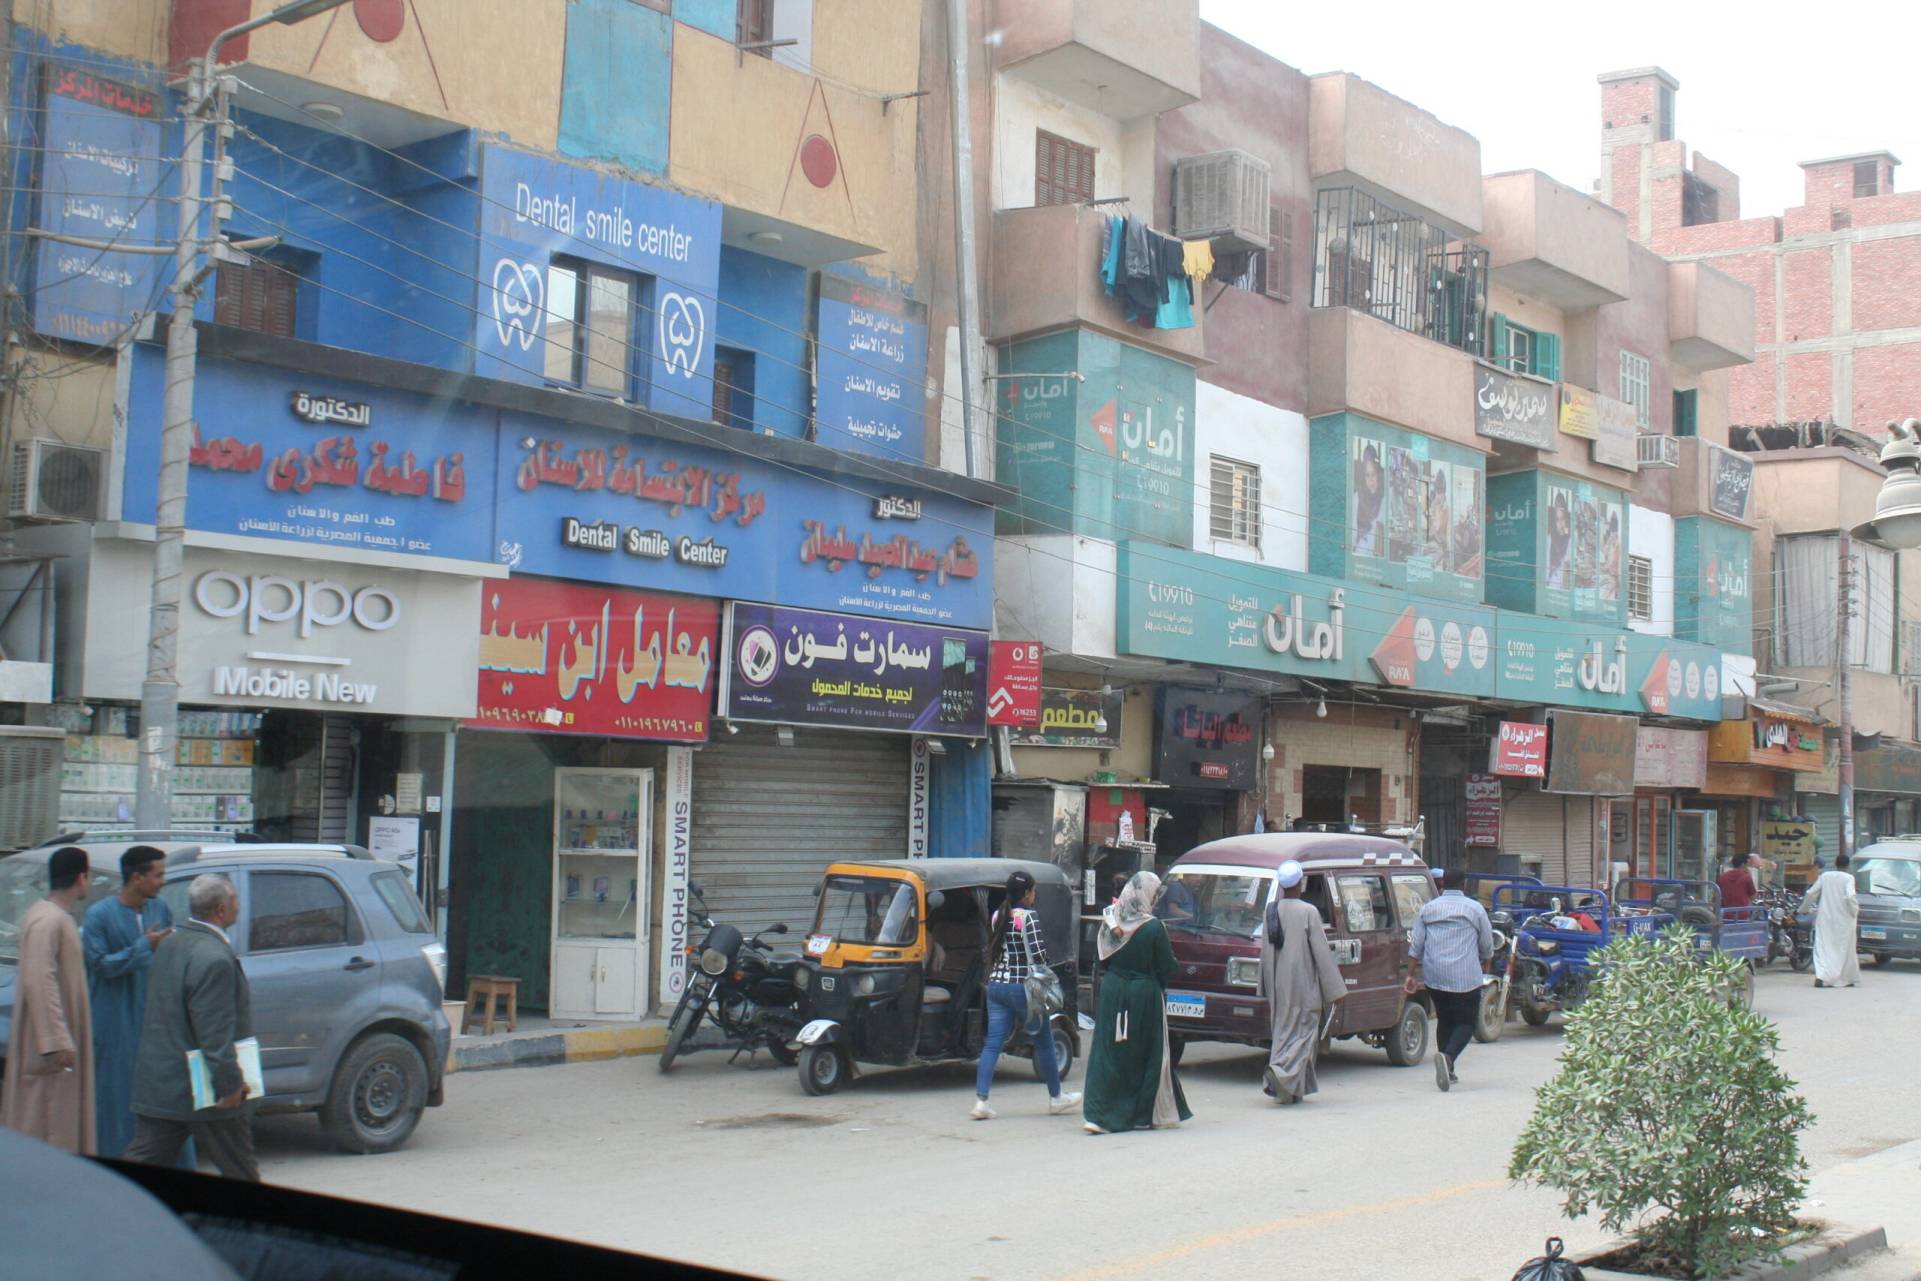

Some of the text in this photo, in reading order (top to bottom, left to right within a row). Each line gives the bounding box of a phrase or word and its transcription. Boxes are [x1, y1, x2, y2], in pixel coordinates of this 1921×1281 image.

[516, 182, 692, 262] Dental smile center
[297, 393, 370, 425] الدكتورة
[1122, 405, 1186, 461] أمان
[363, 440, 465, 501] فاطمة
[608, 445, 712, 518] الابتسامة
[709, 472, 766, 527] مركز
[877, 496, 921, 518] الدكتور
[1495, 500, 1531, 520] أمان
[281, 522, 316, 538] لزراعة
[343, 511, 369, 525] الفم
[374, 513, 396, 527] طب
[316, 526, 361, 543] المصرية
[408, 537, 431, 550] عضو
[567, 519, 728, 566] Dental Smile Center
[917, 592, 932, 601] طب
[1158, 583, 1193, 606] 19910
[1228, 593, 1258, 612] للتمويل
[1227, 614, 1257, 633] متناهي
[1263, 588, 1345, 661] أمان
[479, 592, 711, 704] معامل ابن سين
[784, 622, 932, 676] سمارت فون
[1227, 633, 1258, 648] الصغر
[1512, 641, 1535, 659] 19910
[1389, 665, 1411, 681] RAYA
[1577, 635, 1626, 695] أمان
[214, 666, 377, 703] Mobile New
[811, 678, 913, 705] لجميع خدمات المحمول
[913, 761, 926, 834] SMART
[670, 801, 688, 968] SMART PHONE
